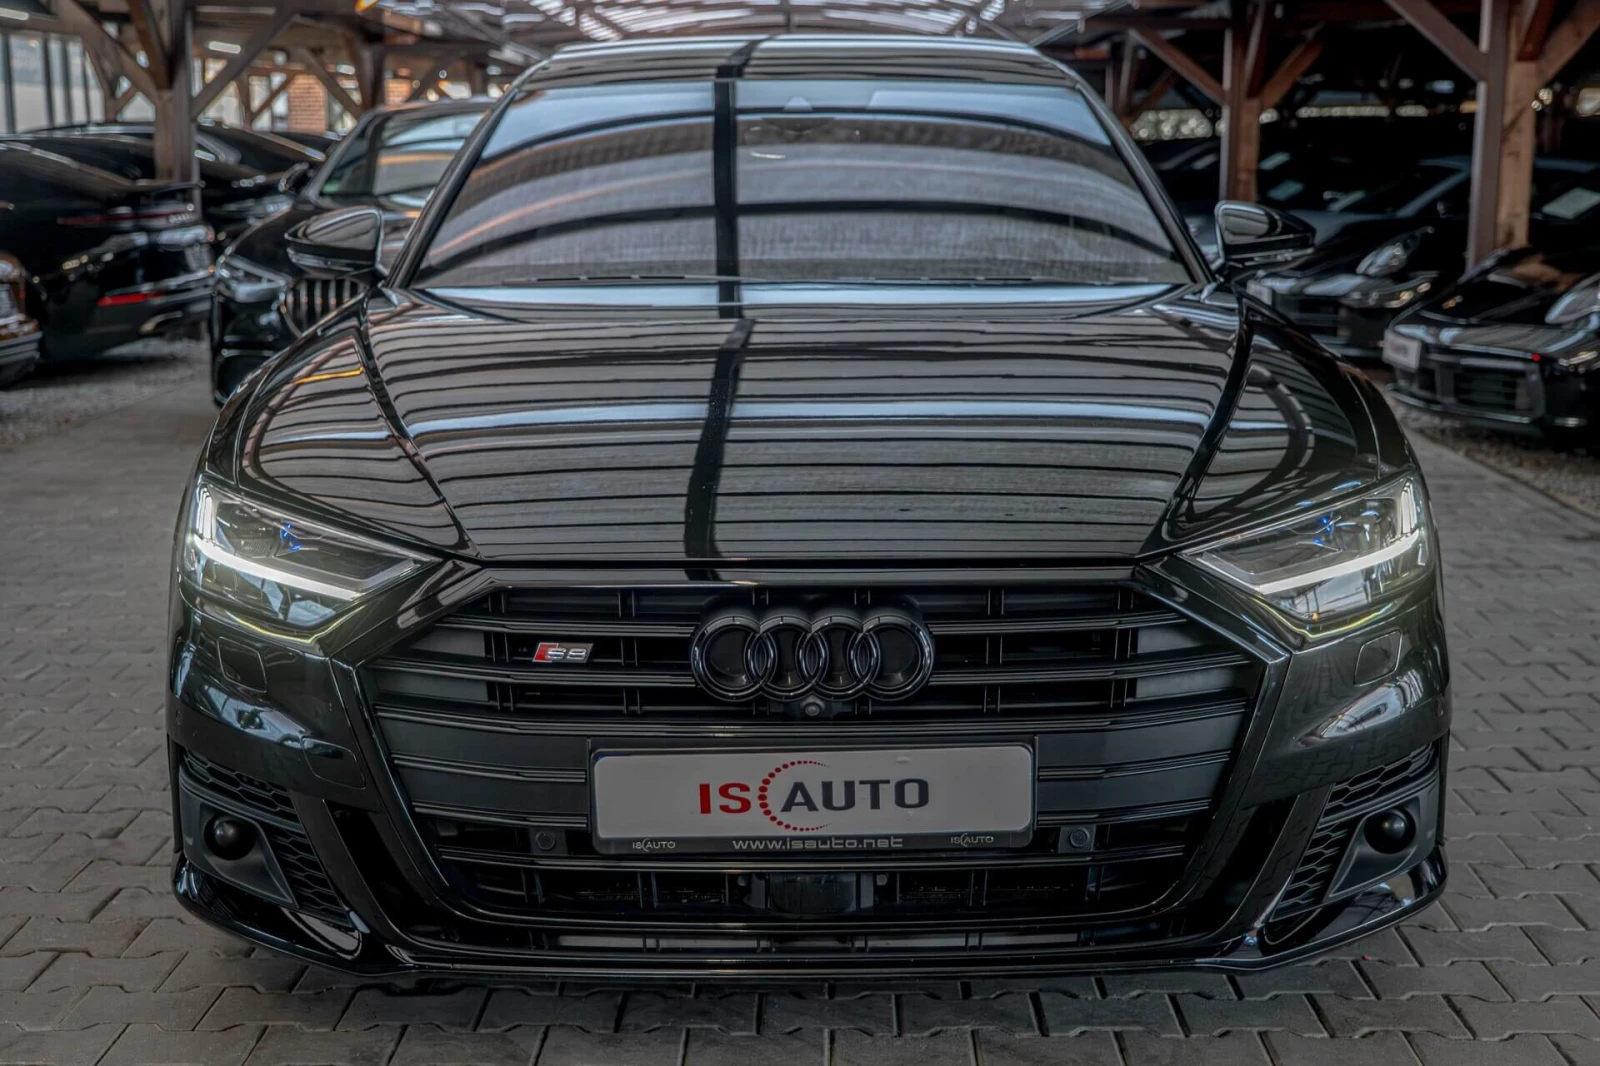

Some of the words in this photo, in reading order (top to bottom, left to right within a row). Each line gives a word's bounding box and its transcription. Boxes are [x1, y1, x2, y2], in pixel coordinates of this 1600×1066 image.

[546, 648, 587, 660] S8
[699, 783, 751, 814] IS
[780, 778, 929, 812] AUTO
[732, 836, 904, 850] www.isauto.net
